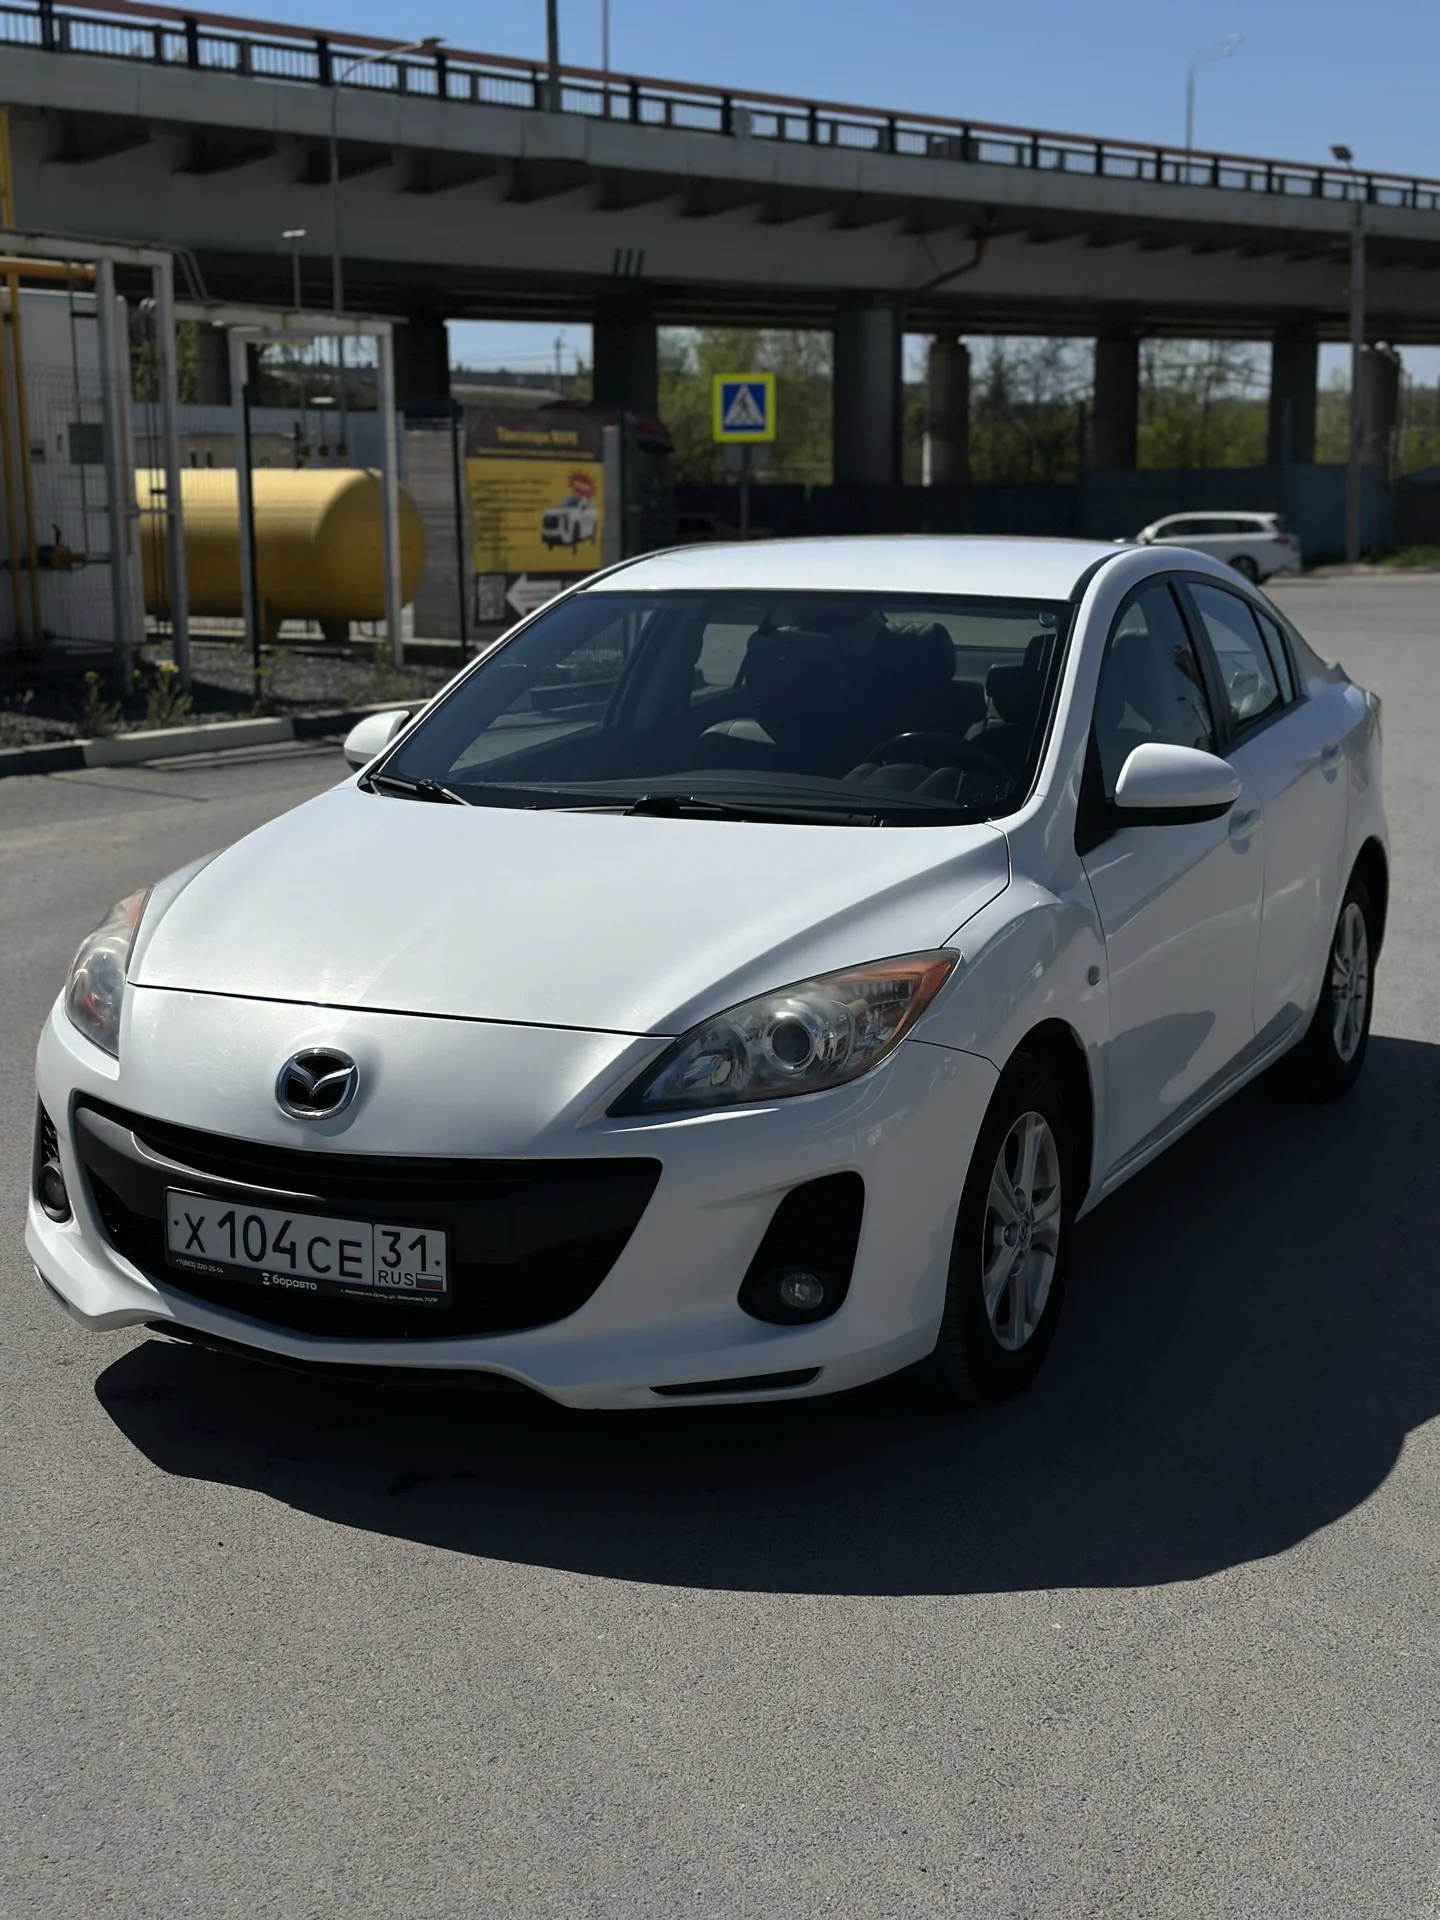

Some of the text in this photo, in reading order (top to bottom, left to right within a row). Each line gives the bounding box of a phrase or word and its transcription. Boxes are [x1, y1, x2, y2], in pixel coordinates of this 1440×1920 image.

[381, 1230, 427, 1272] 31
[272, 1274, 318, 1291] боравто
[378, 1270, 414, 1286] RUS
